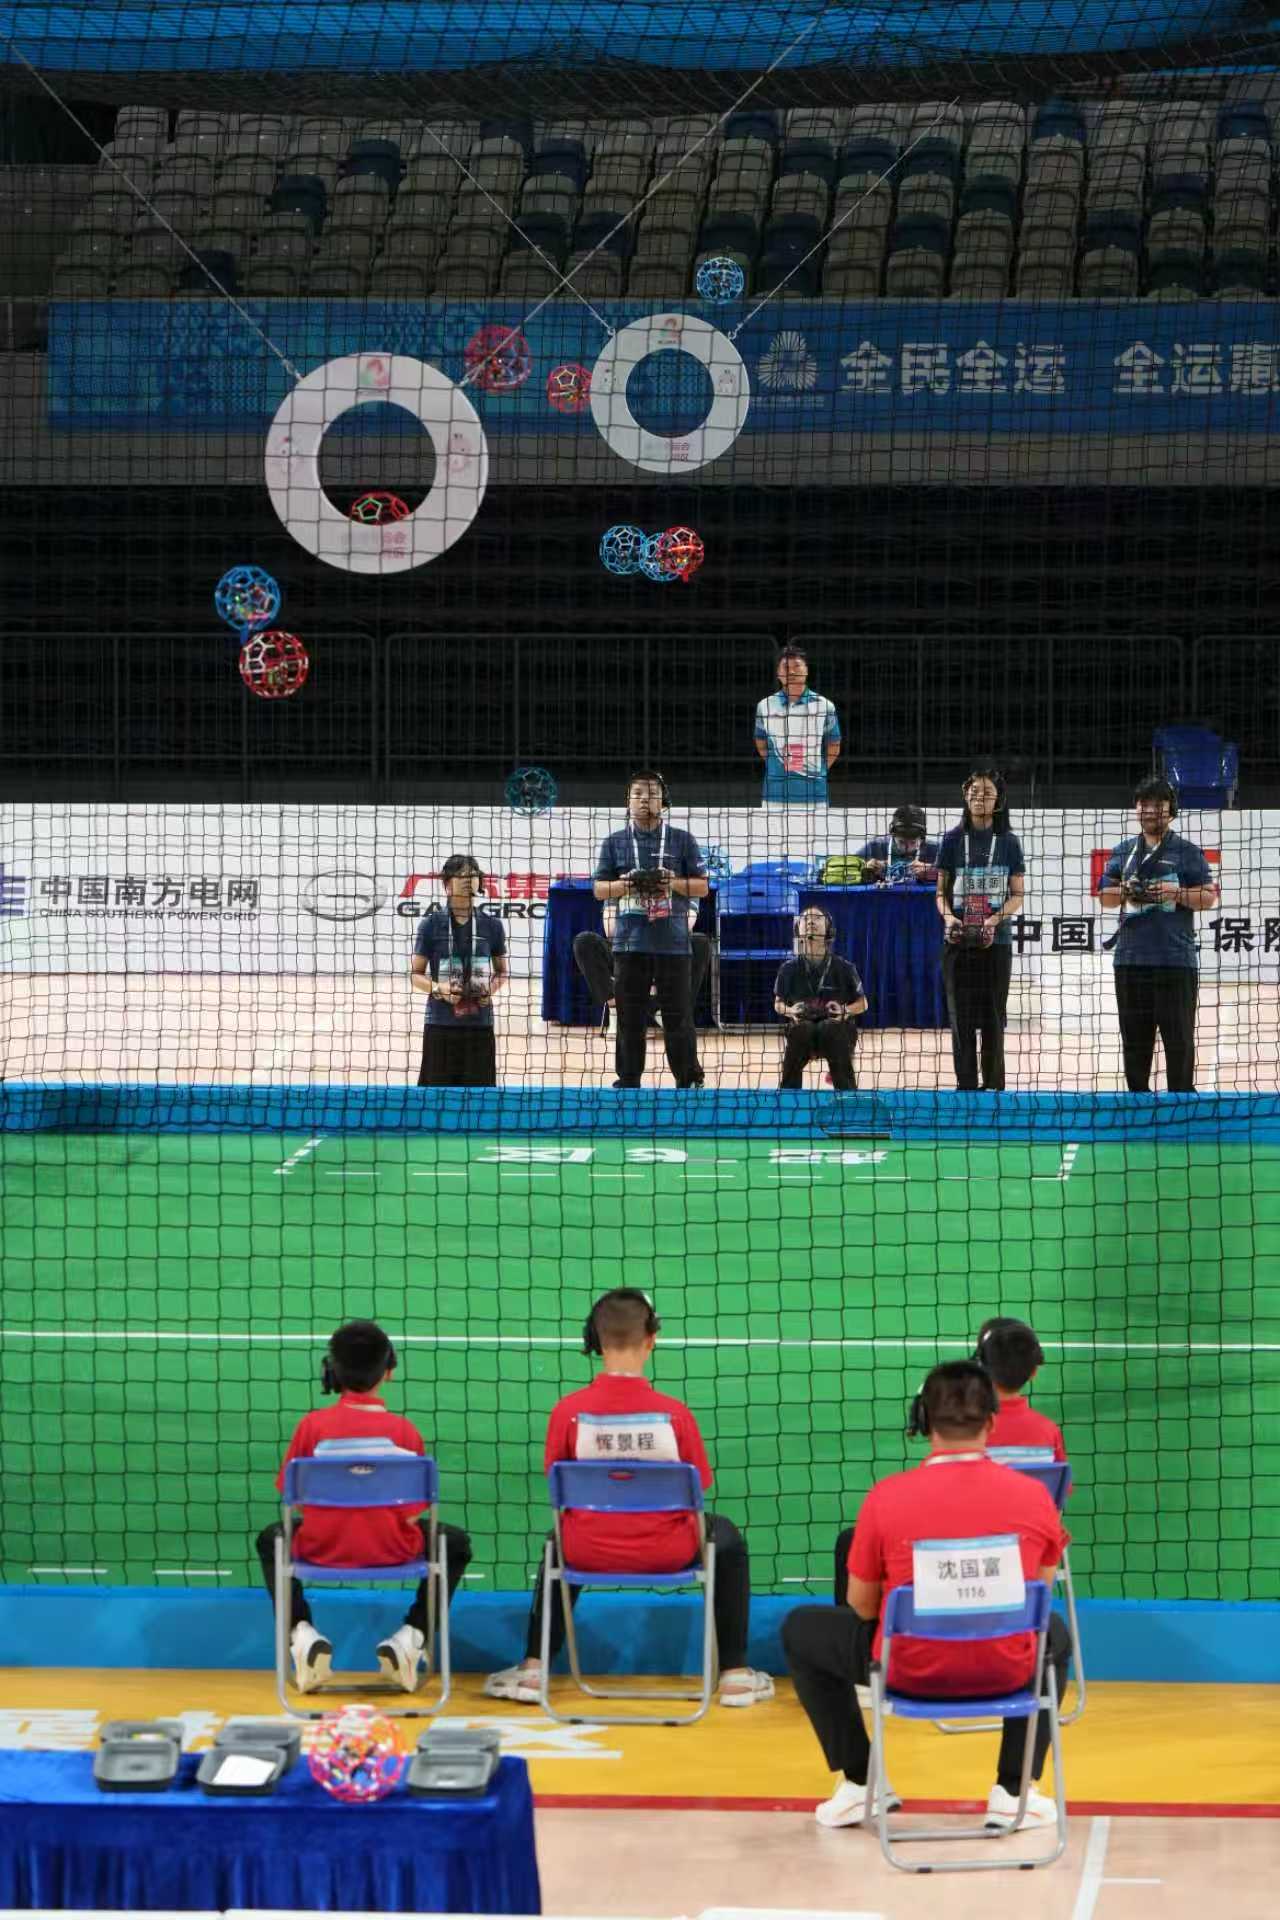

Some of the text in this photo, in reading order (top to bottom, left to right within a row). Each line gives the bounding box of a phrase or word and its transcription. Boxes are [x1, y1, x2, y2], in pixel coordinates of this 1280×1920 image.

[840, 340, 1065, 395] 全民全运
[40, 876, 259, 909] 中国南方电网
[40, 908, 257, 921] CHINA SOUTHERN POWER GRID
[938, 1557, 1000, 1580] 沈国富
[957, 1586, 986, 1598] 1116
